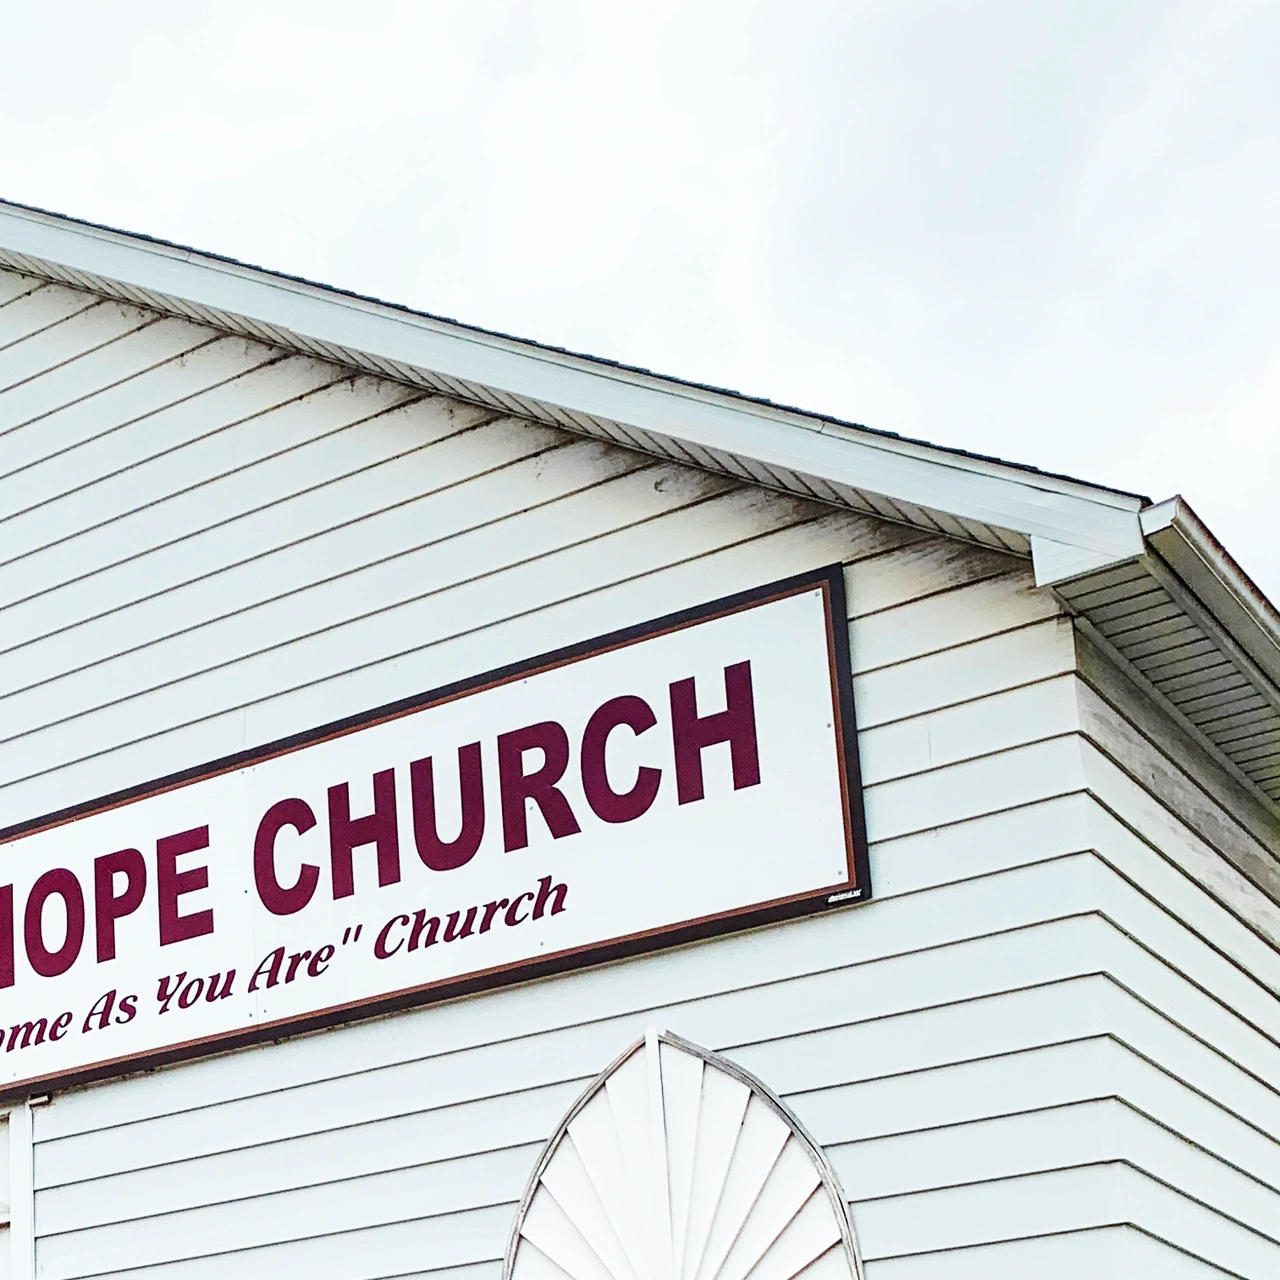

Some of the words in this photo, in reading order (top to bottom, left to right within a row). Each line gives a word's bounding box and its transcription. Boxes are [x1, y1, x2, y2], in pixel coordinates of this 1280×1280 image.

[253, 660, 762, 916] CHURCH
[82, 989, 138, 1034] As
[156, 969, 237, 1015] You
[247, 924, 362, 994] Are"
[374, 874, 568, 960] Church
